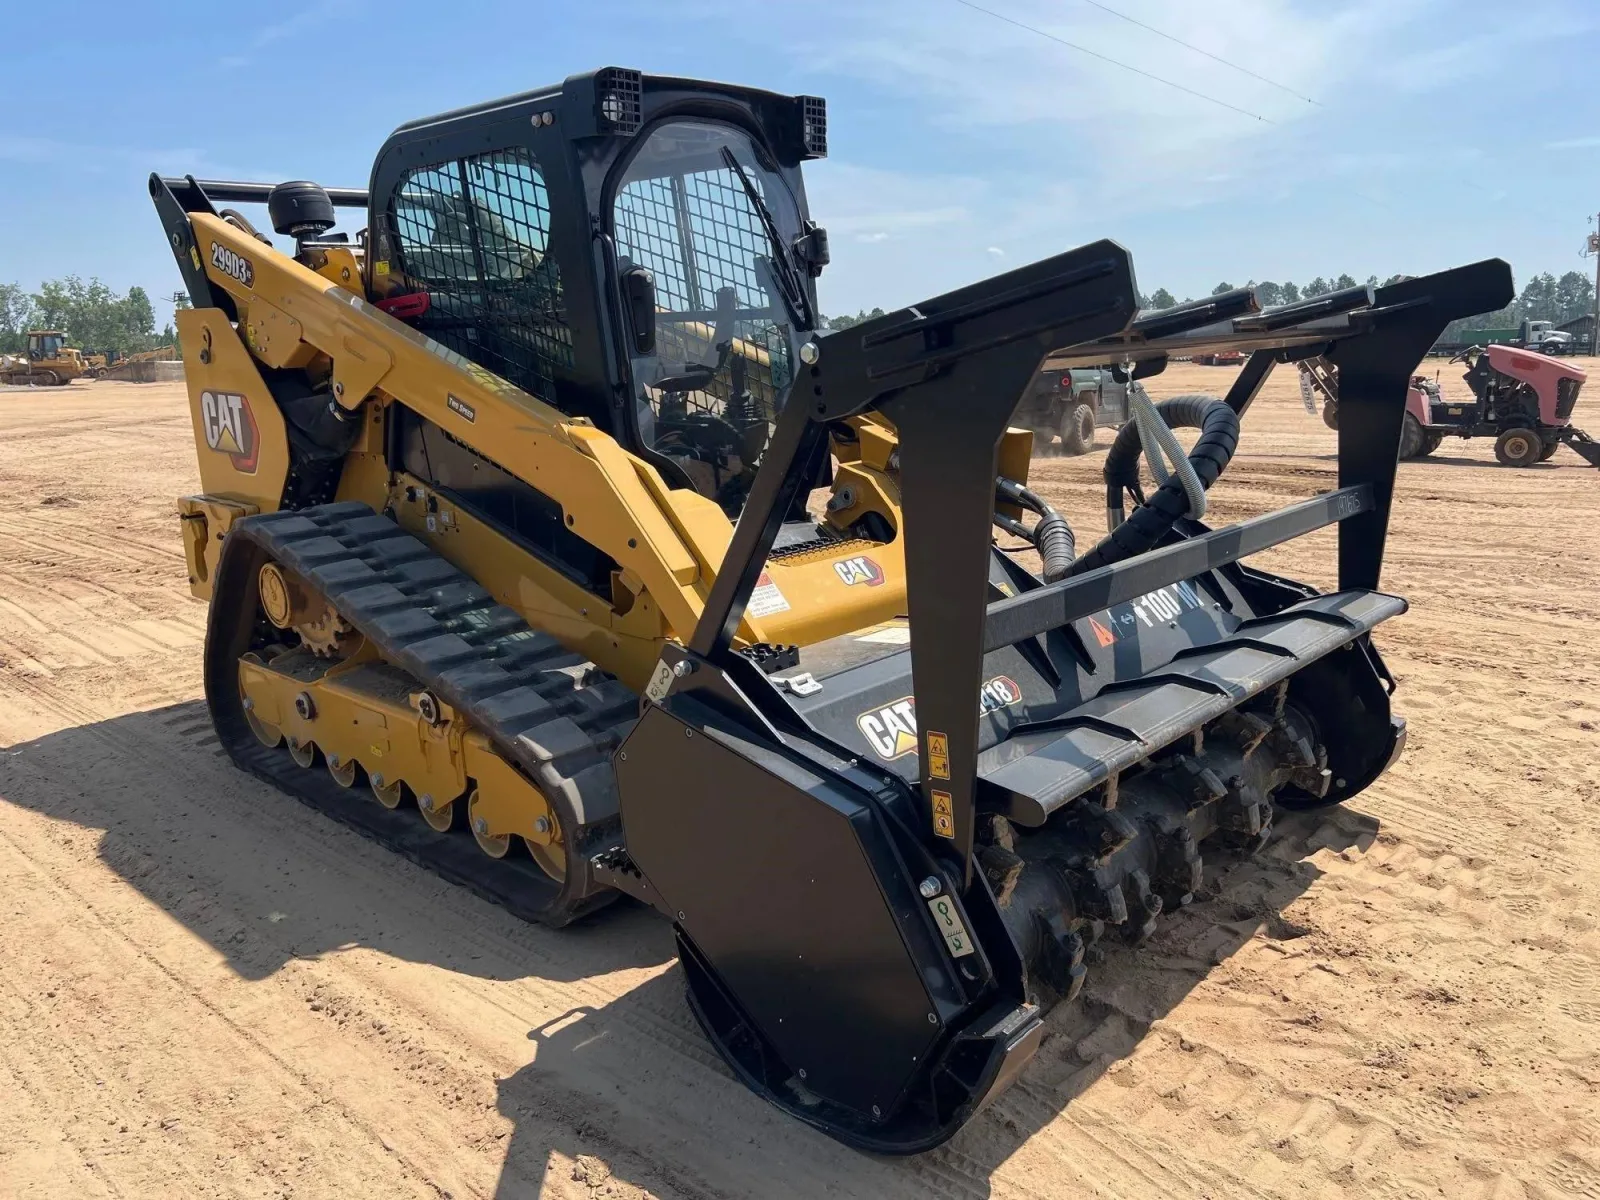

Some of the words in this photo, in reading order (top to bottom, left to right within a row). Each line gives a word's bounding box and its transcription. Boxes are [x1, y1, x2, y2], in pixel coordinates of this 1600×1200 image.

[211, 241, 247, 283] 299D3
[202, 391, 245, 454] CAT
[833, 557, 875, 585] CAT
[1140, 588, 1183, 623] 100
[859, 700, 918, 758] CAT
